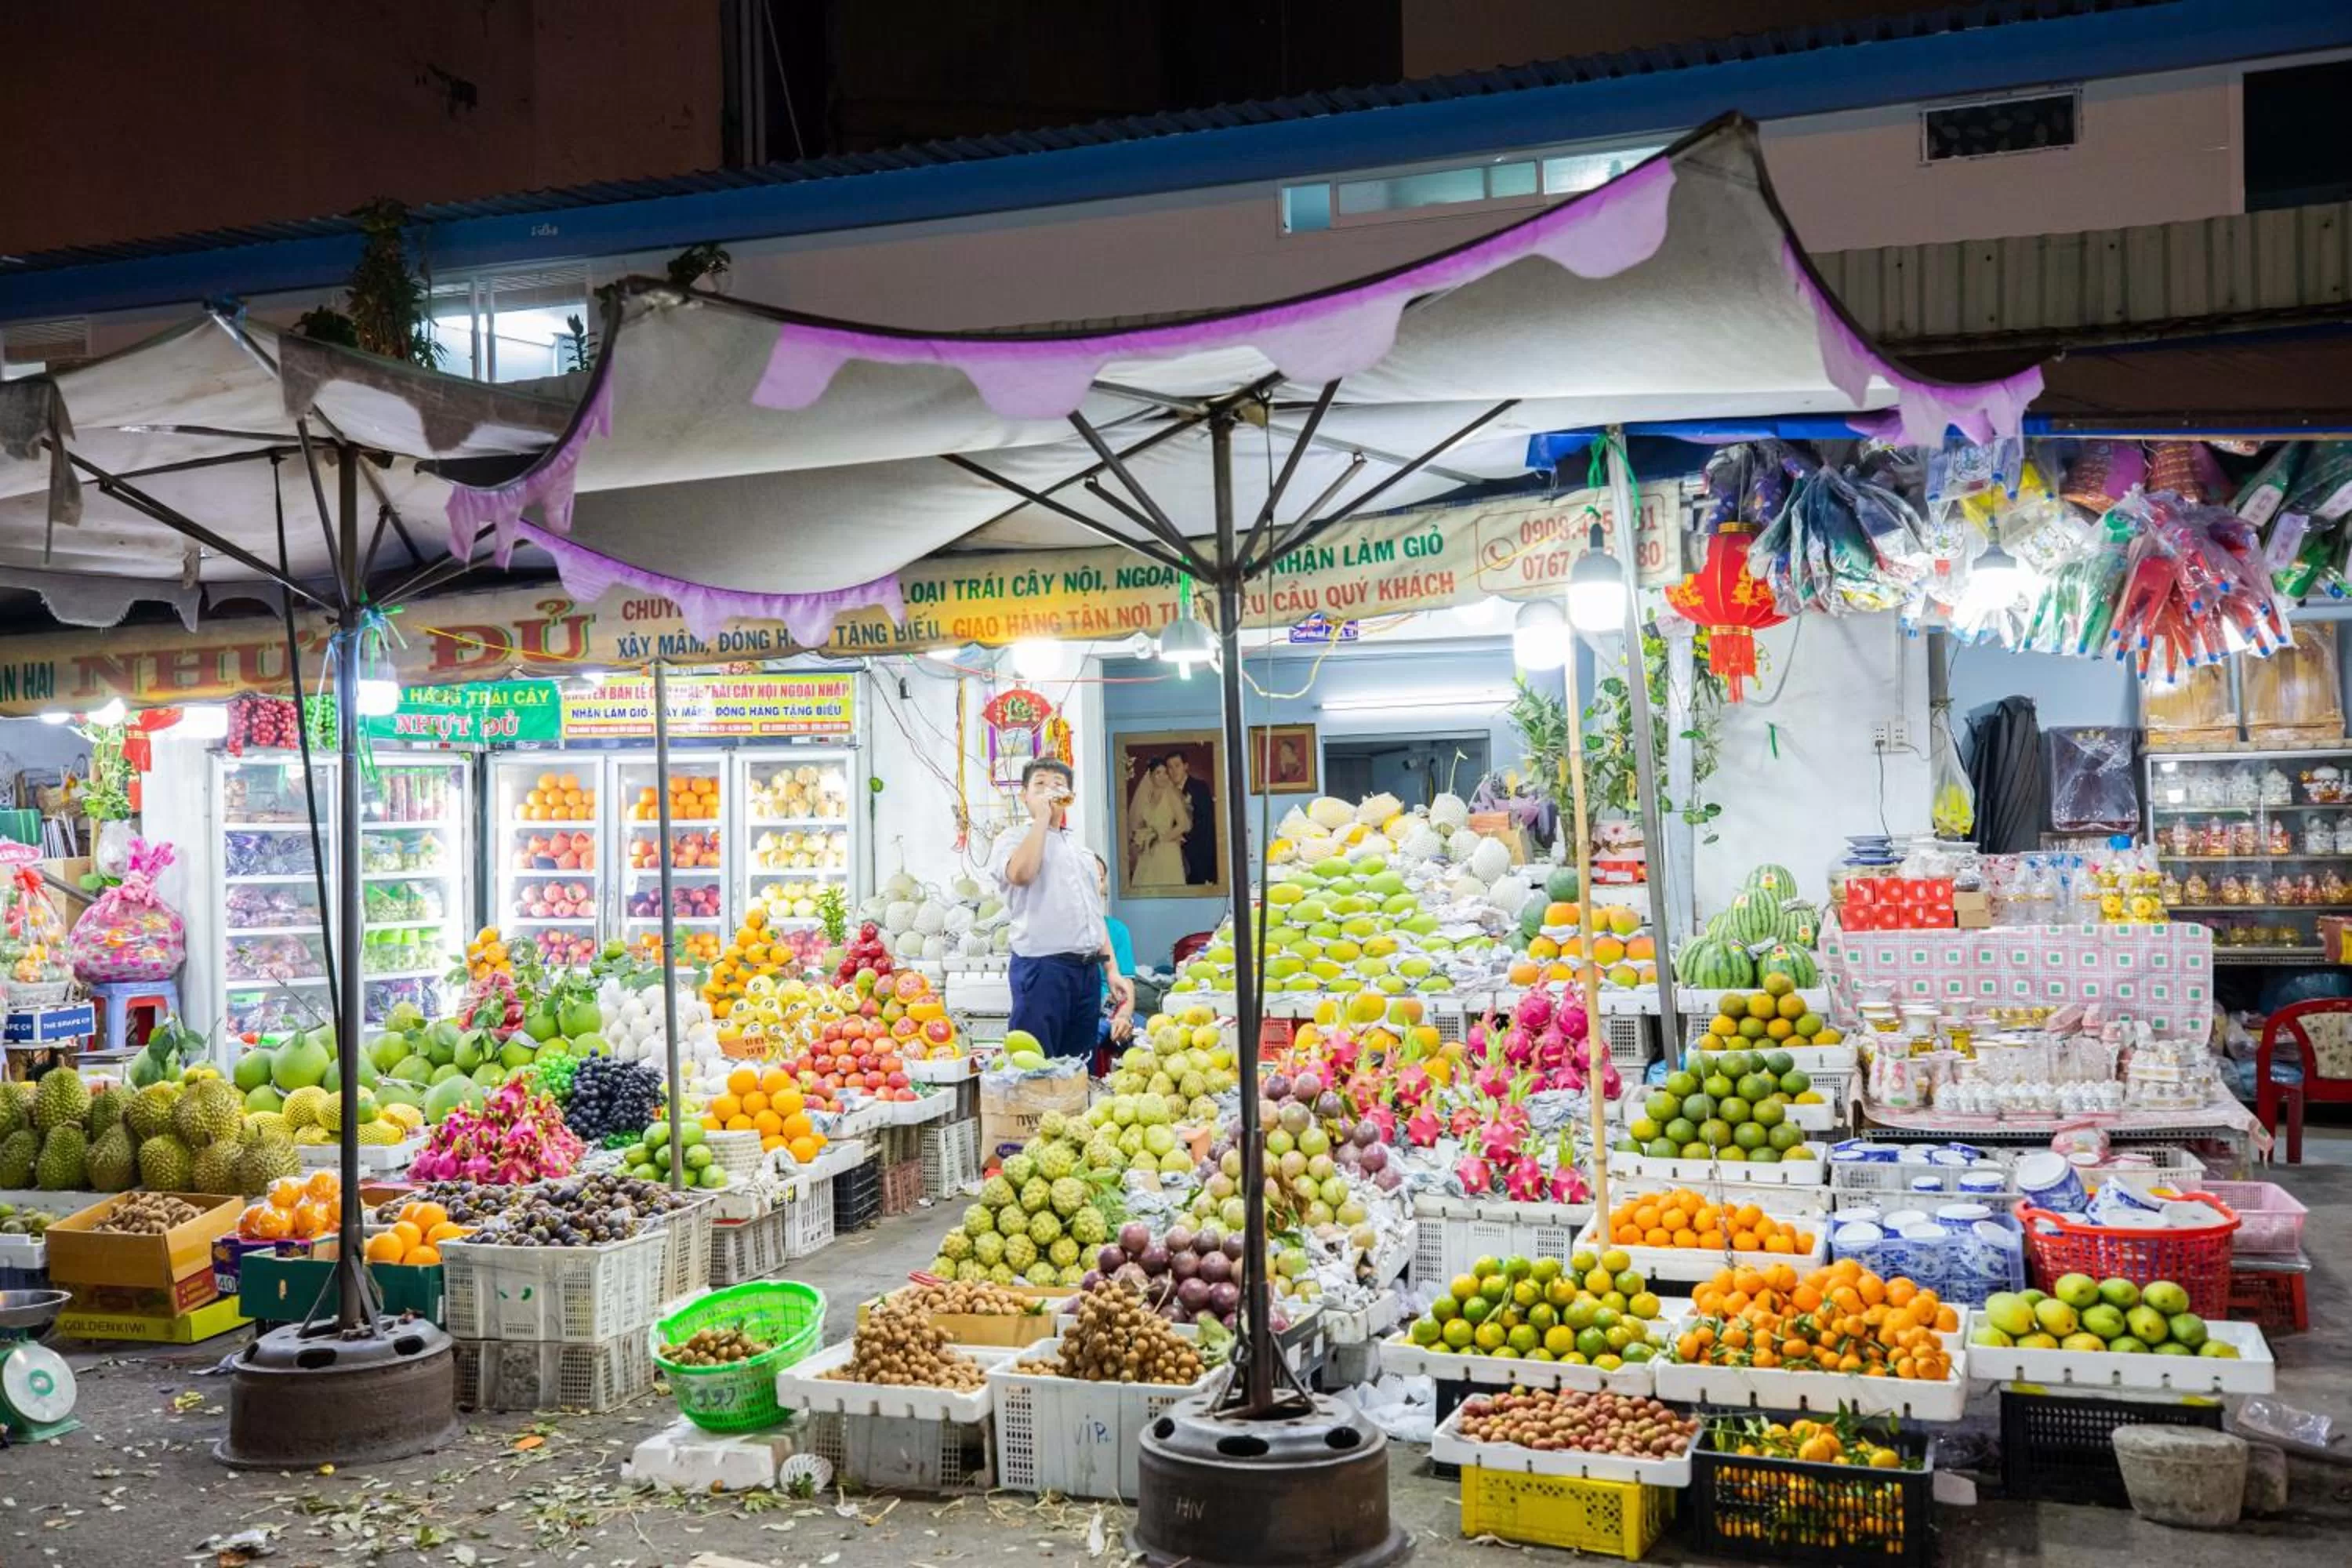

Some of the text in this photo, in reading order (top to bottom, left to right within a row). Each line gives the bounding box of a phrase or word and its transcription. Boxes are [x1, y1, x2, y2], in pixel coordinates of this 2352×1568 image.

[1271, 543, 1334, 575] NHẬN
[1342, 537, 1395, 567] LÀM
[1403, 524, 1444, 557] GIỎ
[953, 571, 1004, 601] TRÁI
[1012, 568, 1055, 597] CÂY
[1063, 564, 1107, 599] NỘI,
[1273, 580, 1318, 612] CẦU
[1326, 576, 1369, 609] QUÝ
[1378, 570, 1454, 601] KHÁCH
[622, 598, 684, 621] CHUY
[953, 616, 998, 639] GIAO
[424, 599, 595, 671] ĐỦ
[617, 631, 652, 657] XÂY
[718, 625, 770, 652] ĐÓNG
[24, 661, 54, 699] HAI
[514, 687, 550, 704] CÂY
